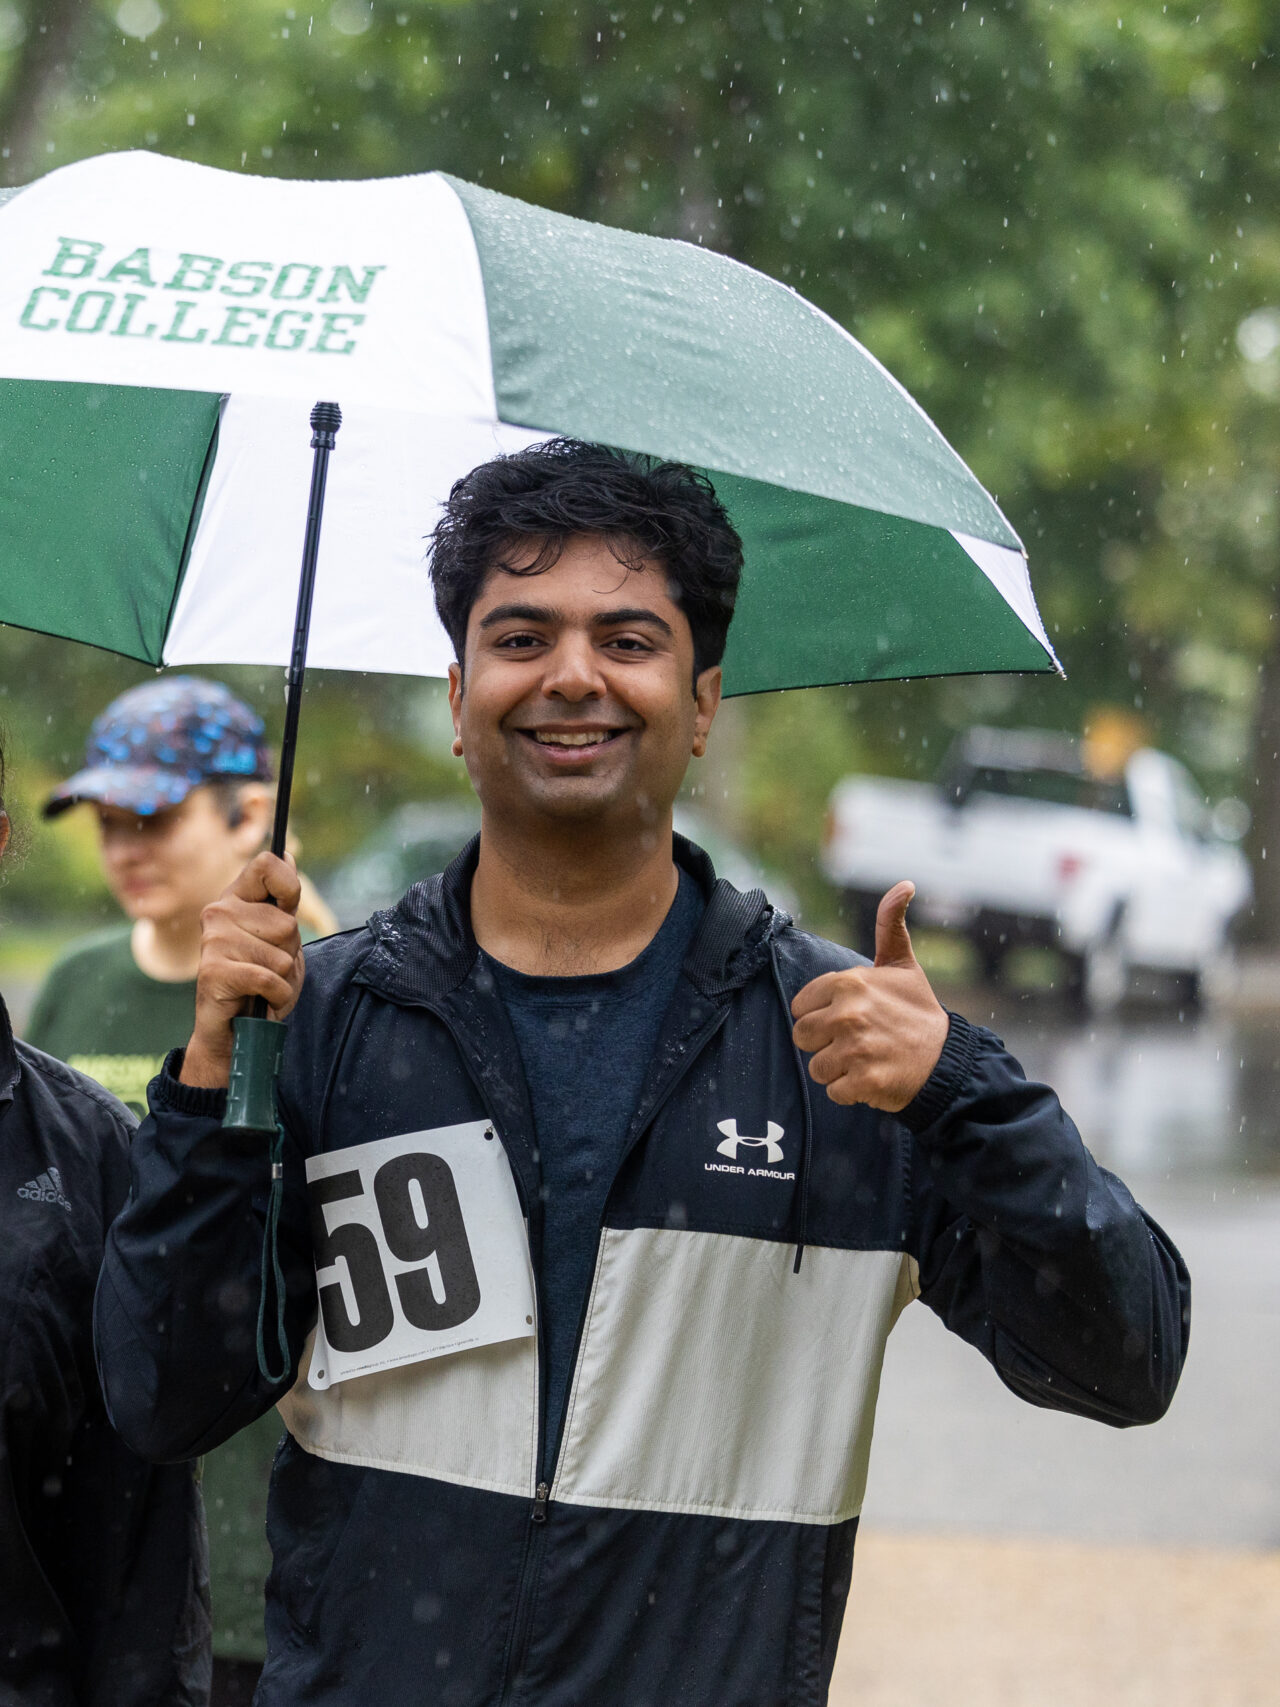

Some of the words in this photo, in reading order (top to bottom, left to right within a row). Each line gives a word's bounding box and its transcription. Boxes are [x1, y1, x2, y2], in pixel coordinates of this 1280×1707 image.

[41, 236, 387, 304] BABSON
[19, 286, 367, 355] COLLEGE
[16, 1187, 72, 1212] adidas
[705, 1163, 744, 1174] UNDER
[748, 1169, 795, 1180] ARMOUR
[306, 1152, 481, 1353] 59
